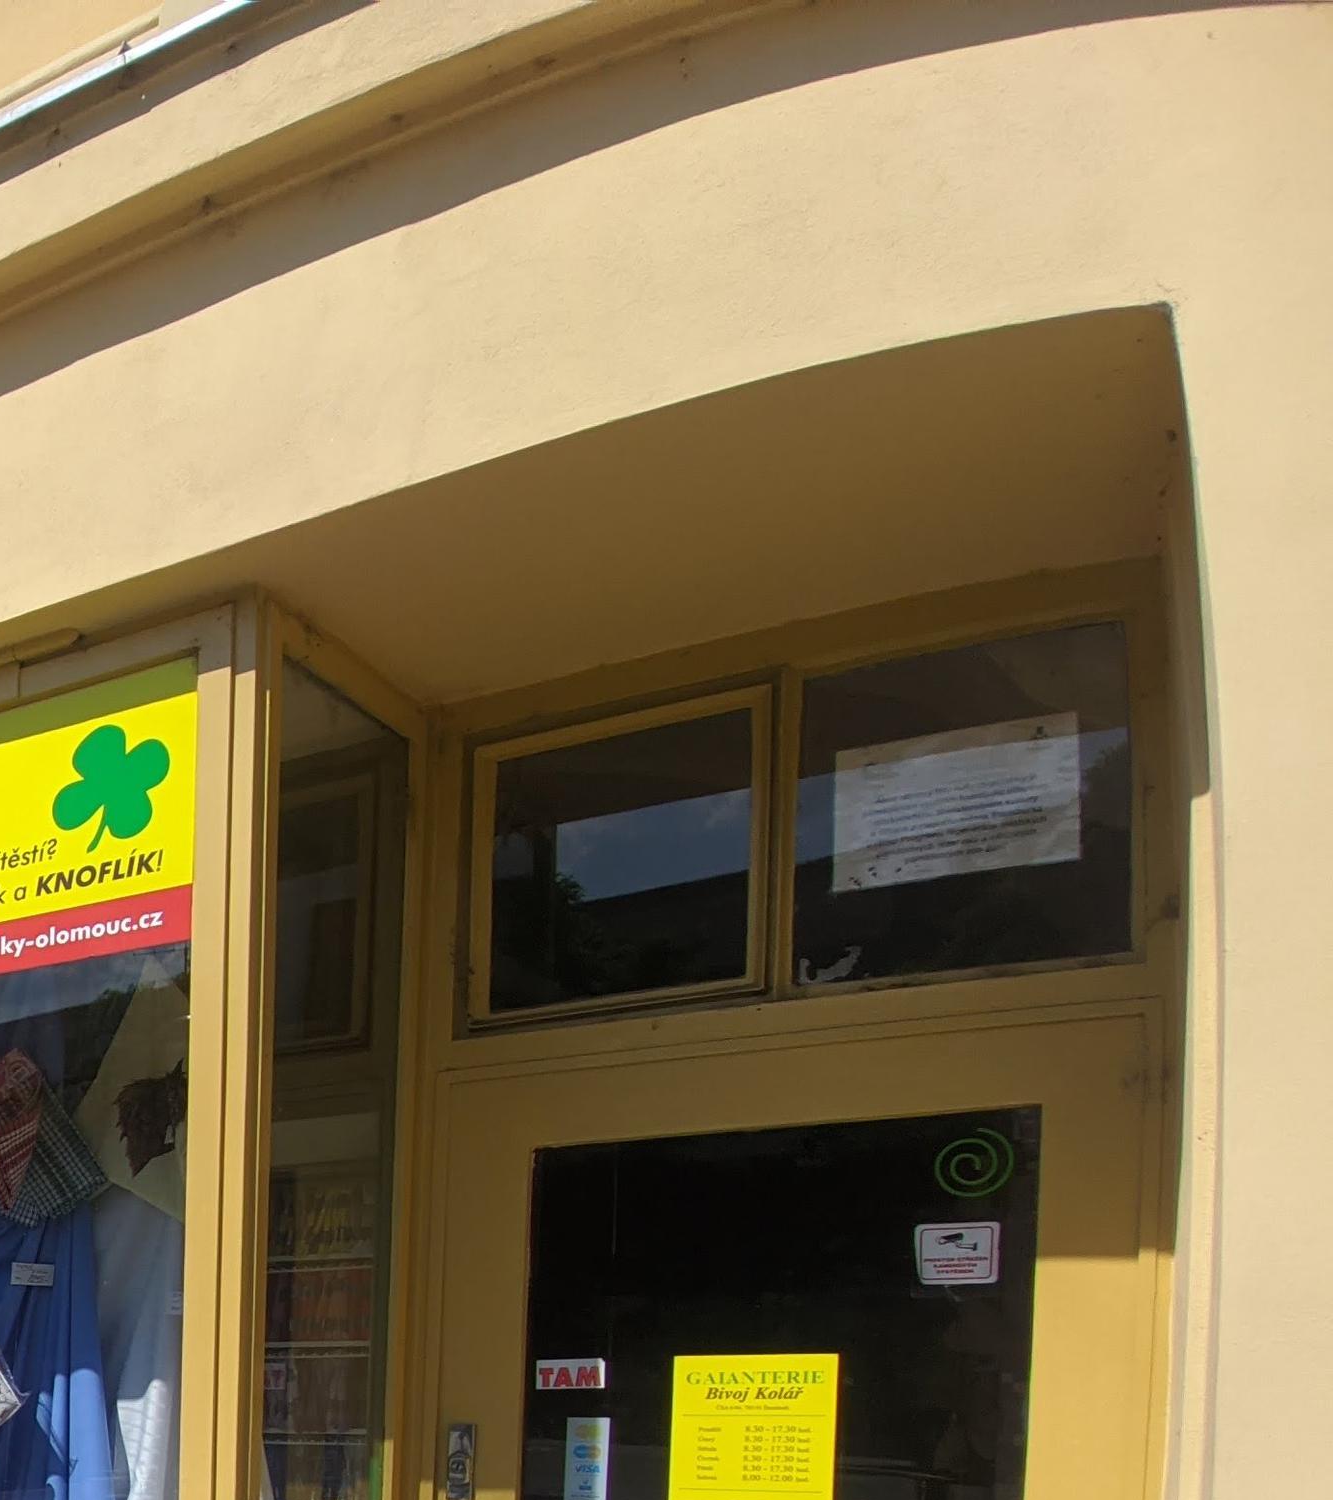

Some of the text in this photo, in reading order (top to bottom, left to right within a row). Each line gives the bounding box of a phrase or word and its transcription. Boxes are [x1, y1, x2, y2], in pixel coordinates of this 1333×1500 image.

[13, 886, 27, 902] a
[35, 849, 164, 896] KNOFLÍK!
[539, 1366, 602, 1387] TAM
[705, 1386, 804, 1403] Bivoj Kolář
